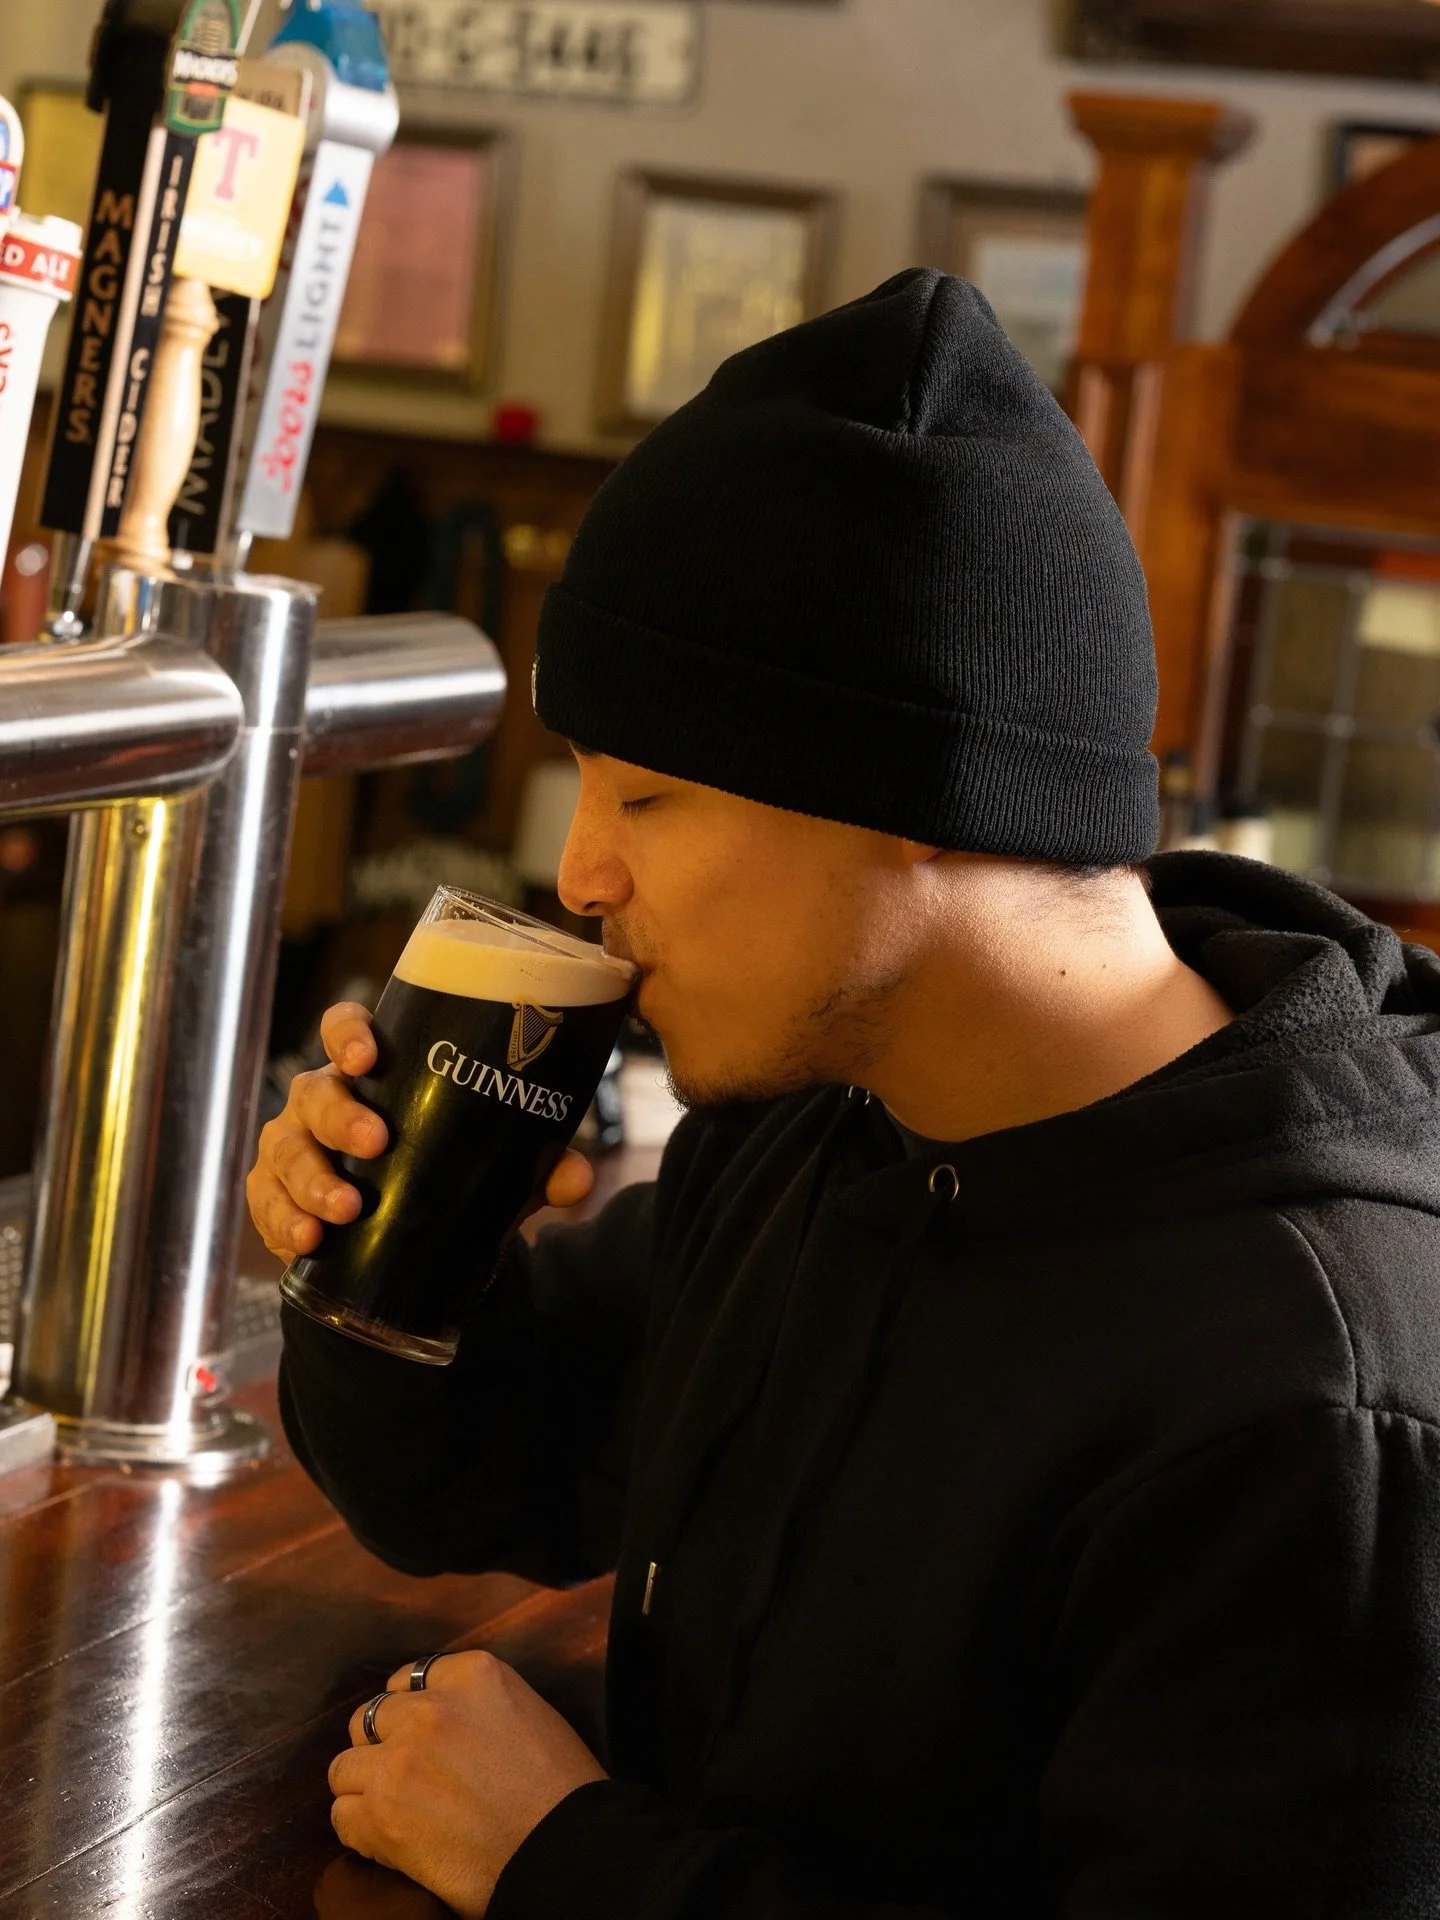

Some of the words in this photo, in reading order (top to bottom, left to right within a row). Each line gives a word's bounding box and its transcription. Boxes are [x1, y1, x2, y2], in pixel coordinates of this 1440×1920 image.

[141, 154, 183, 317] IRISH
[212, 126, 260, 200] T
[65, 189, 134, 443] MAGNERS
[294, 219, 342, 350] LIGHT
[106, 348, 149, 508] CIDER
[427, 1040, 573, 1122] GUINNESS
